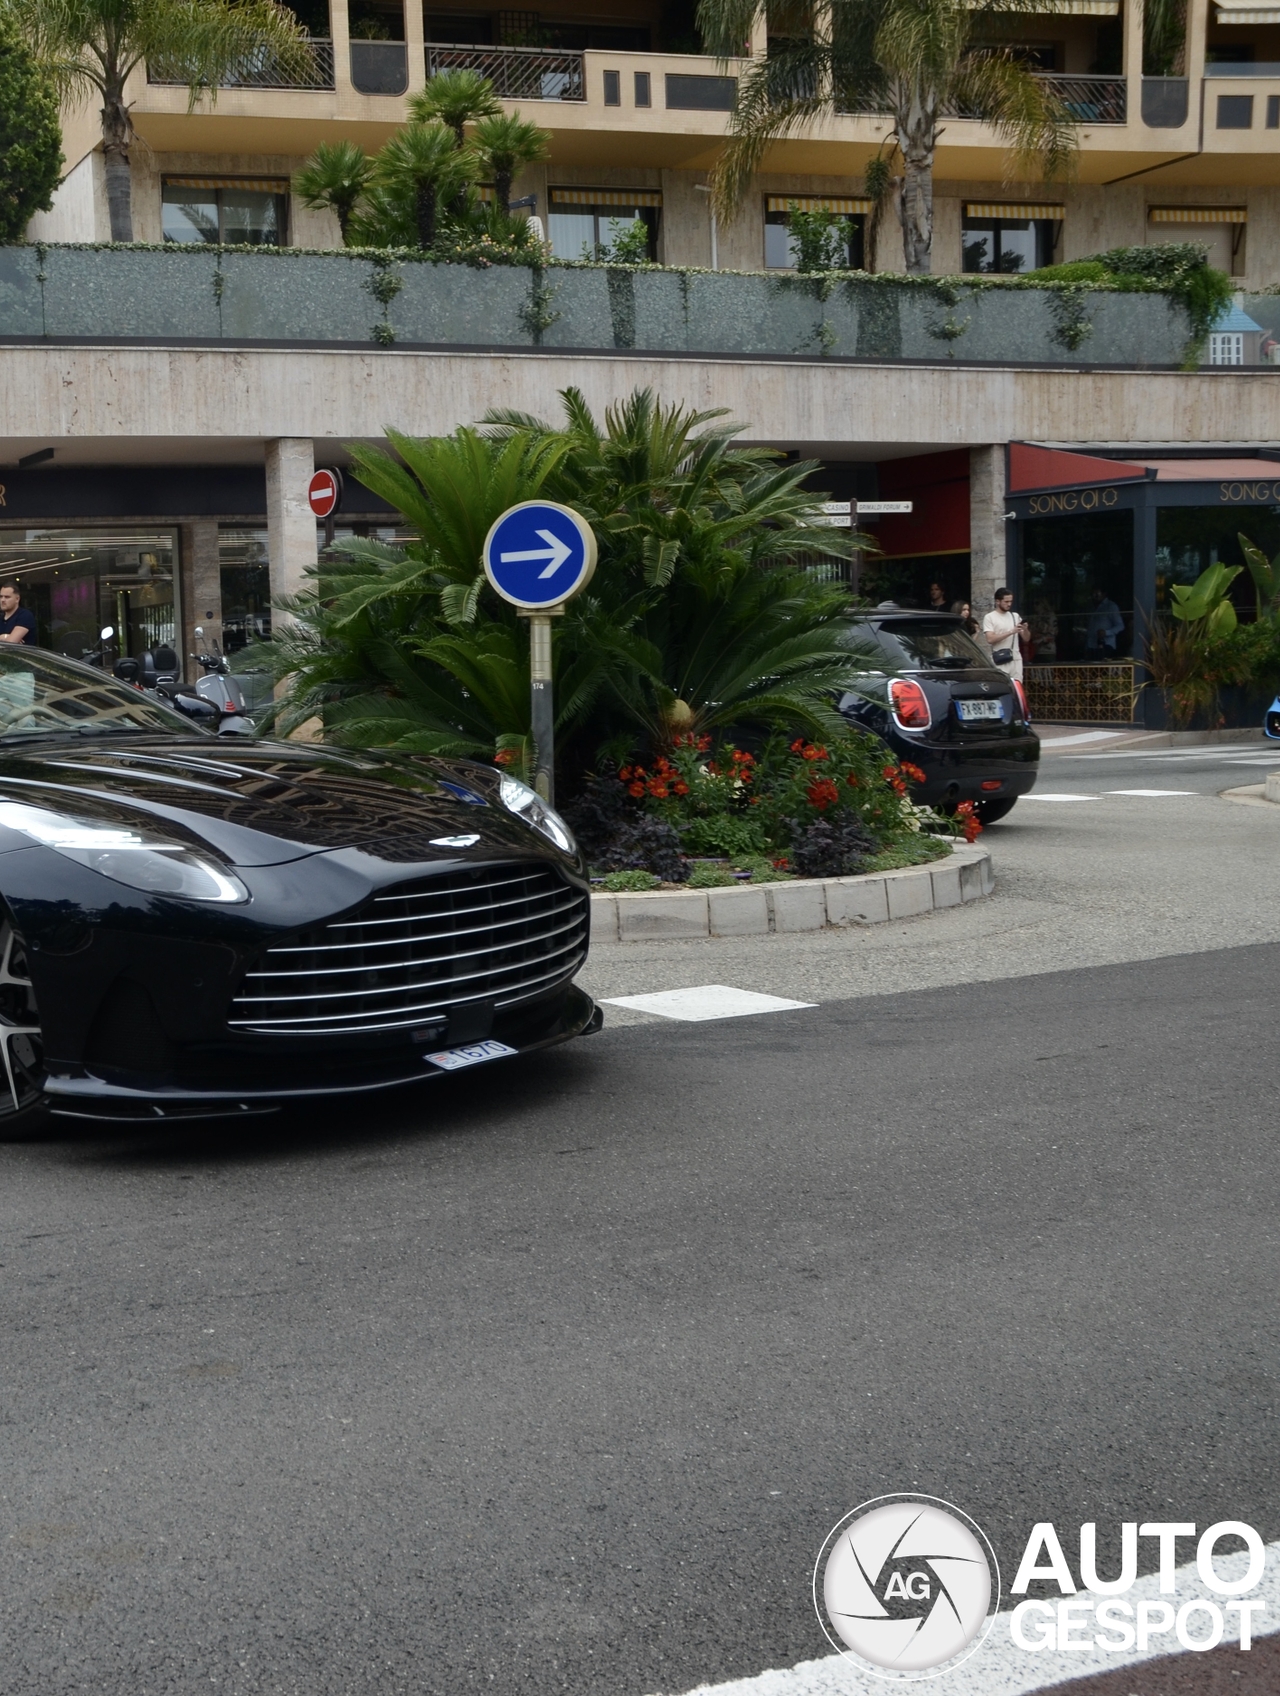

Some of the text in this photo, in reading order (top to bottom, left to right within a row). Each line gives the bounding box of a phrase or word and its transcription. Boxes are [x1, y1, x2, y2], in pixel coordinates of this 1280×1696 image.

[1220, 482, 1270, 501] SONG
[1029, 489, 1099, 514] SONG QI
[449, 1042, 507, 1061] 1670
